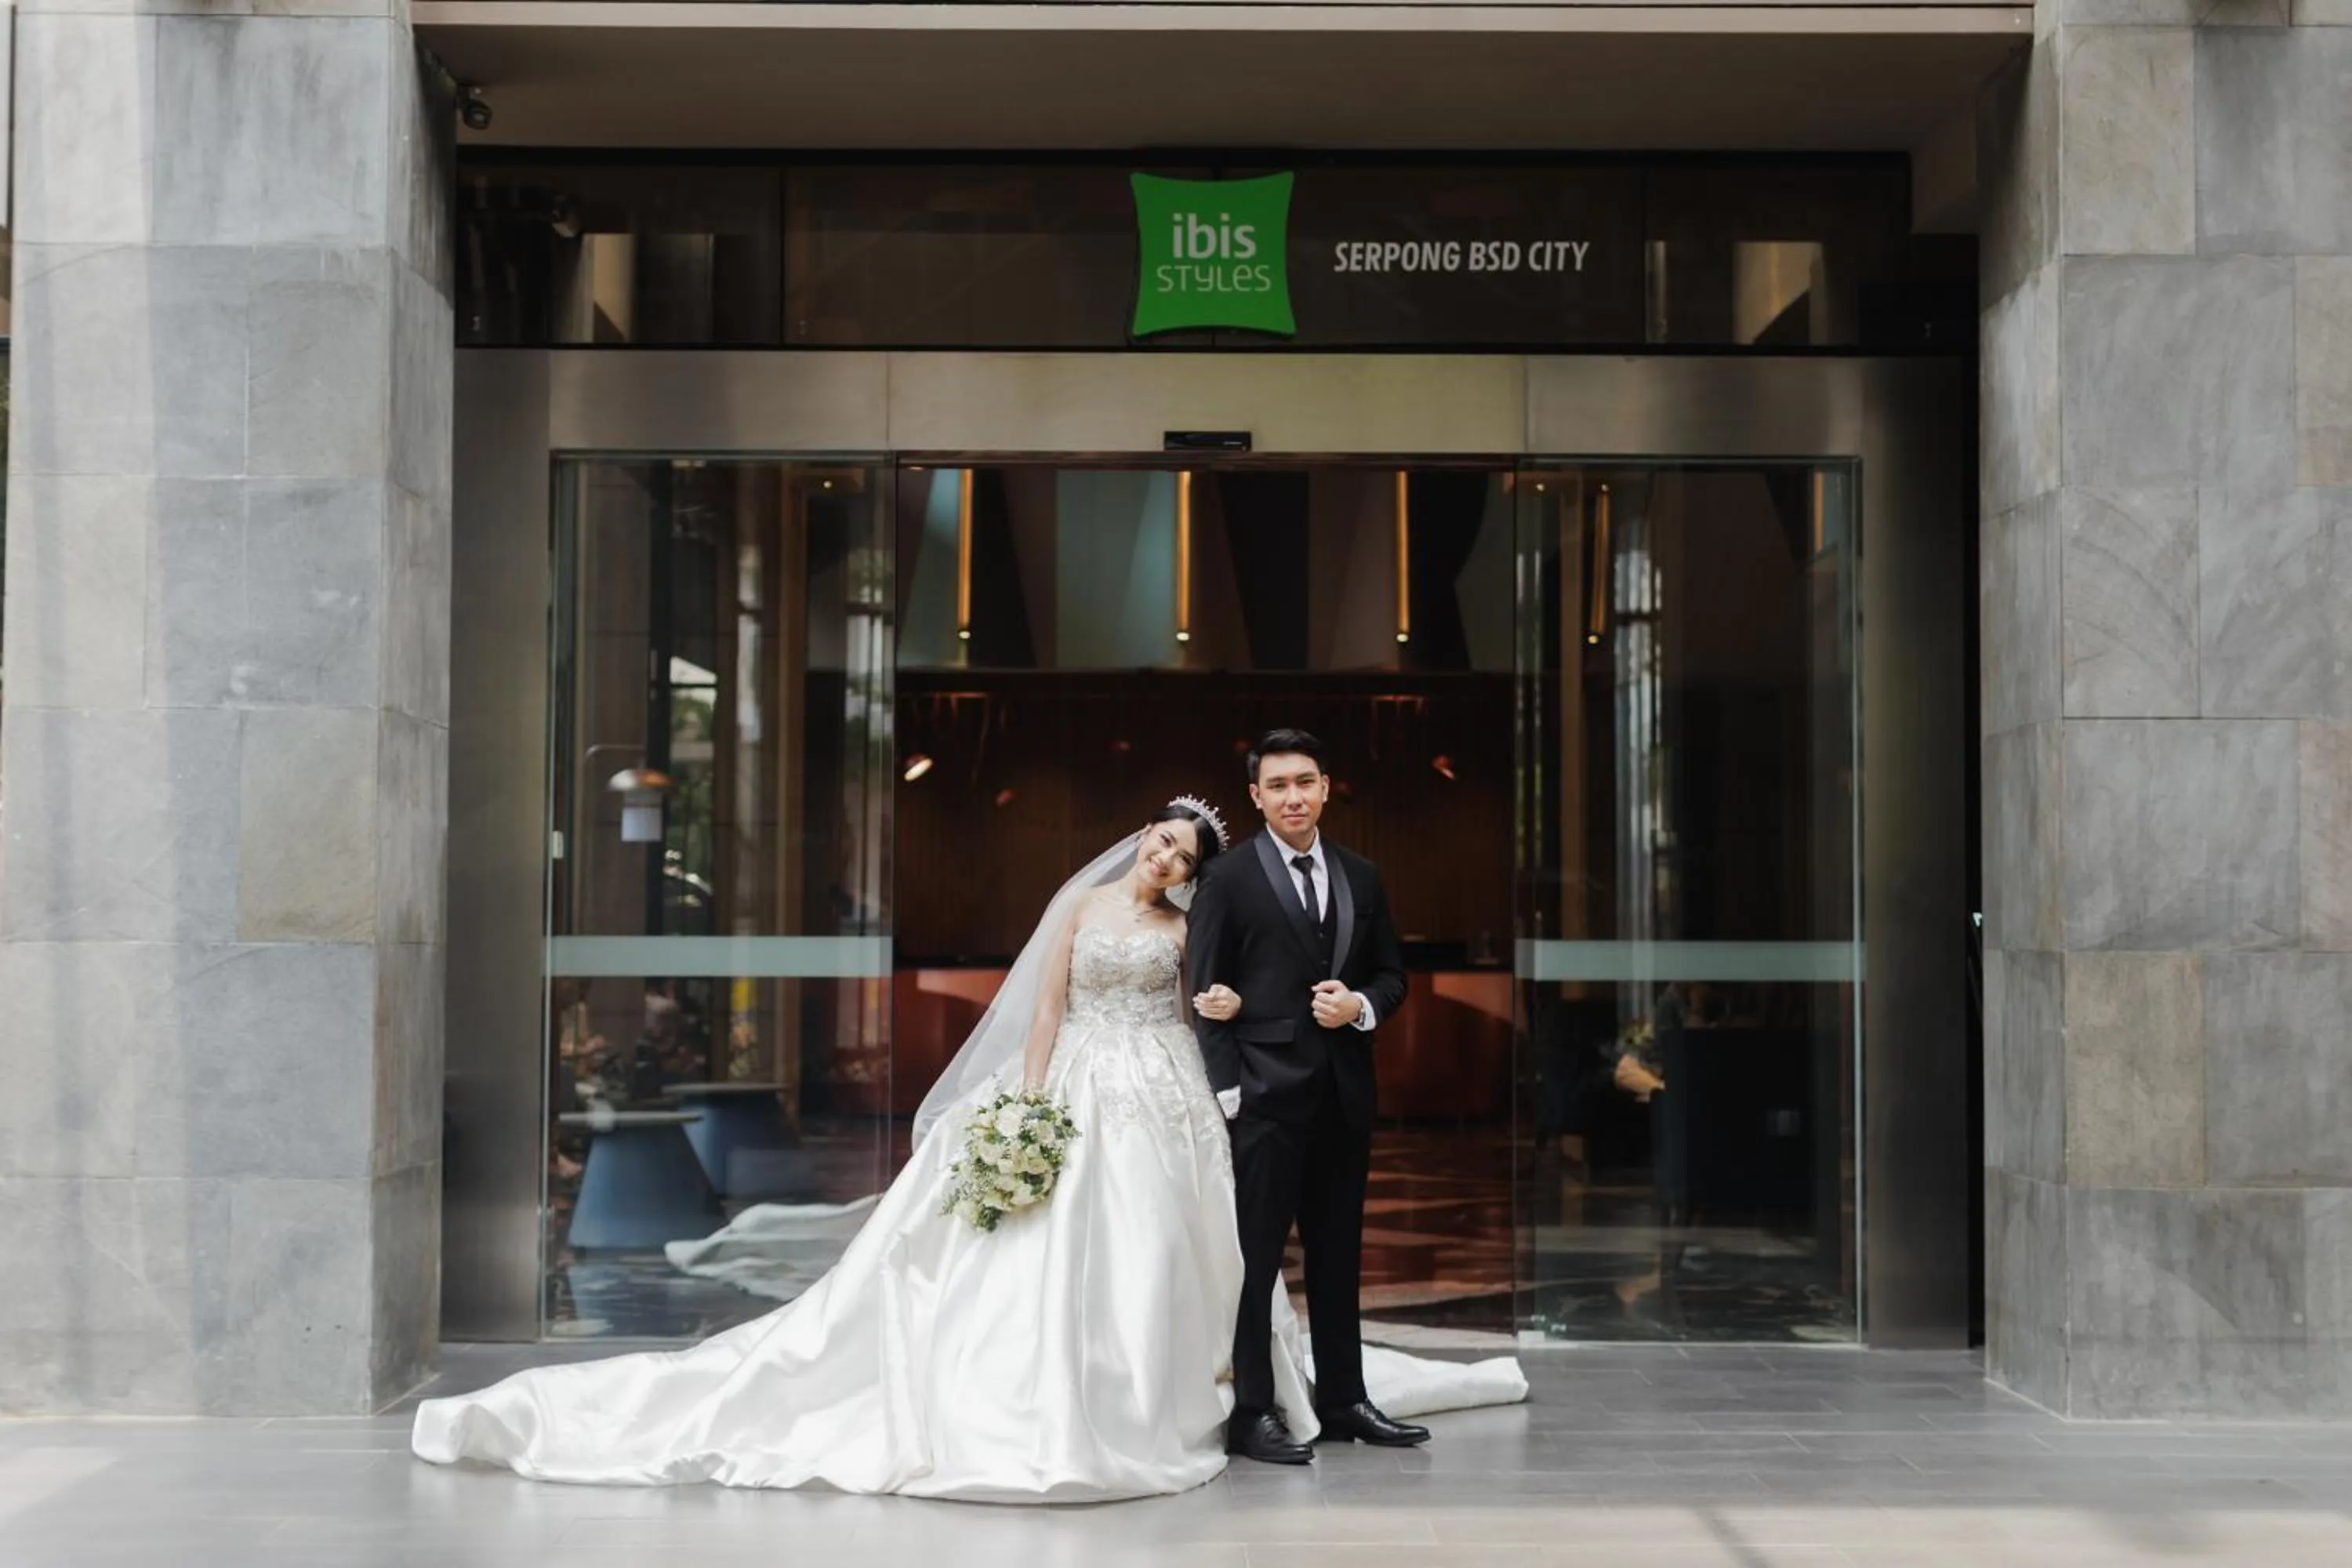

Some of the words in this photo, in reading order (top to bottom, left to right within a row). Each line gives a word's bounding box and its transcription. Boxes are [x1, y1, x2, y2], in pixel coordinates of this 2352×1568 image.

[1173, 212, 1257, 259] ibis
[1334, 241, 1461, 272] SERPONG
[1468, 241, 1521, 271] BSD
[1527, 241, 1590, 271] CITY
